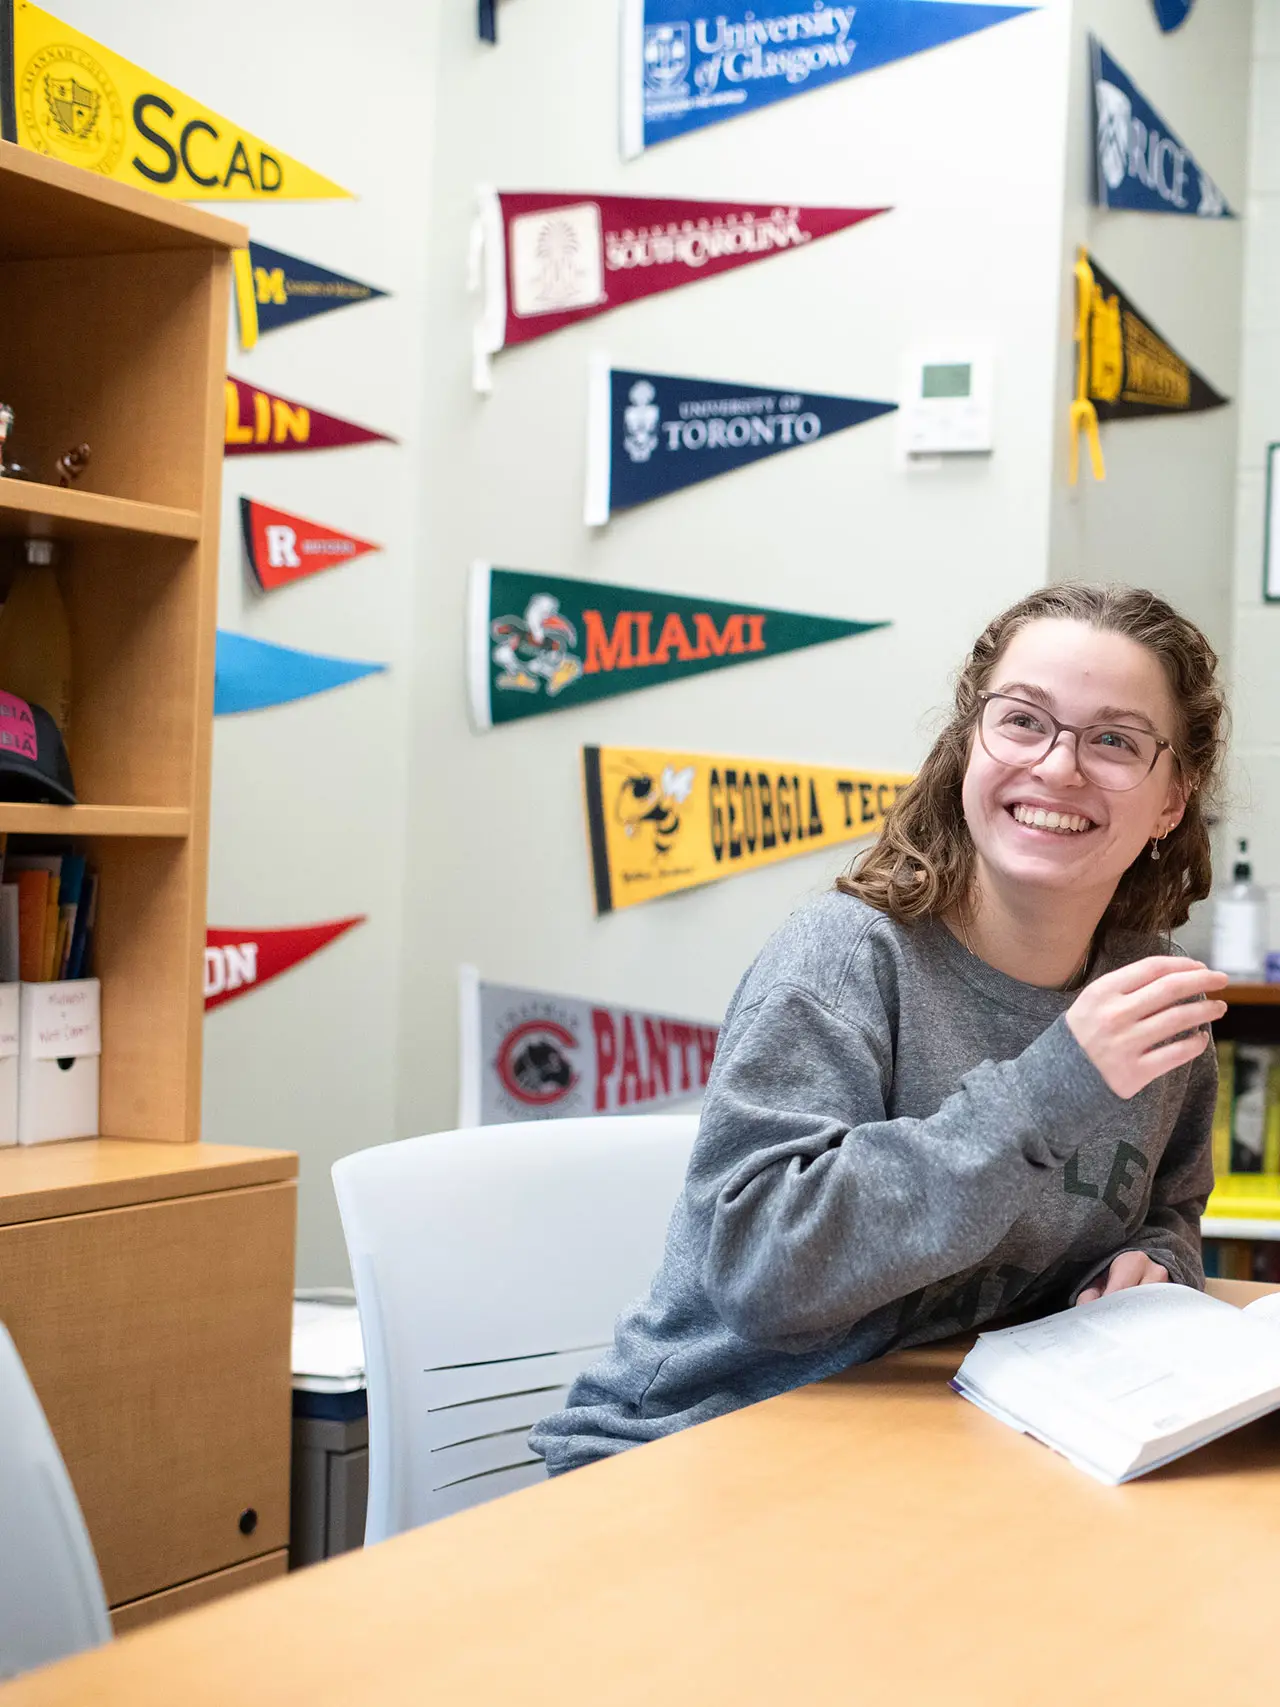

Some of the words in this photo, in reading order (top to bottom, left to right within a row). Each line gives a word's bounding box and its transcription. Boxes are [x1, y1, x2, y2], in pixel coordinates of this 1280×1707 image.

[694, 1, 857, 53] University
[694, 52, 726, 95] of
[722, 41, 857, 83] Glasgow
[132, 93, 283, 192] SCAD
[254, 267, 288, 305] M
[224, 381, 310, 444] LIN
[662, 412, 822, 450] TORONTO
[264, 525, 301, 568] R
[582, 610, 767, 675] MIAMI
[709, 766, 823, 863] GEORGIA
